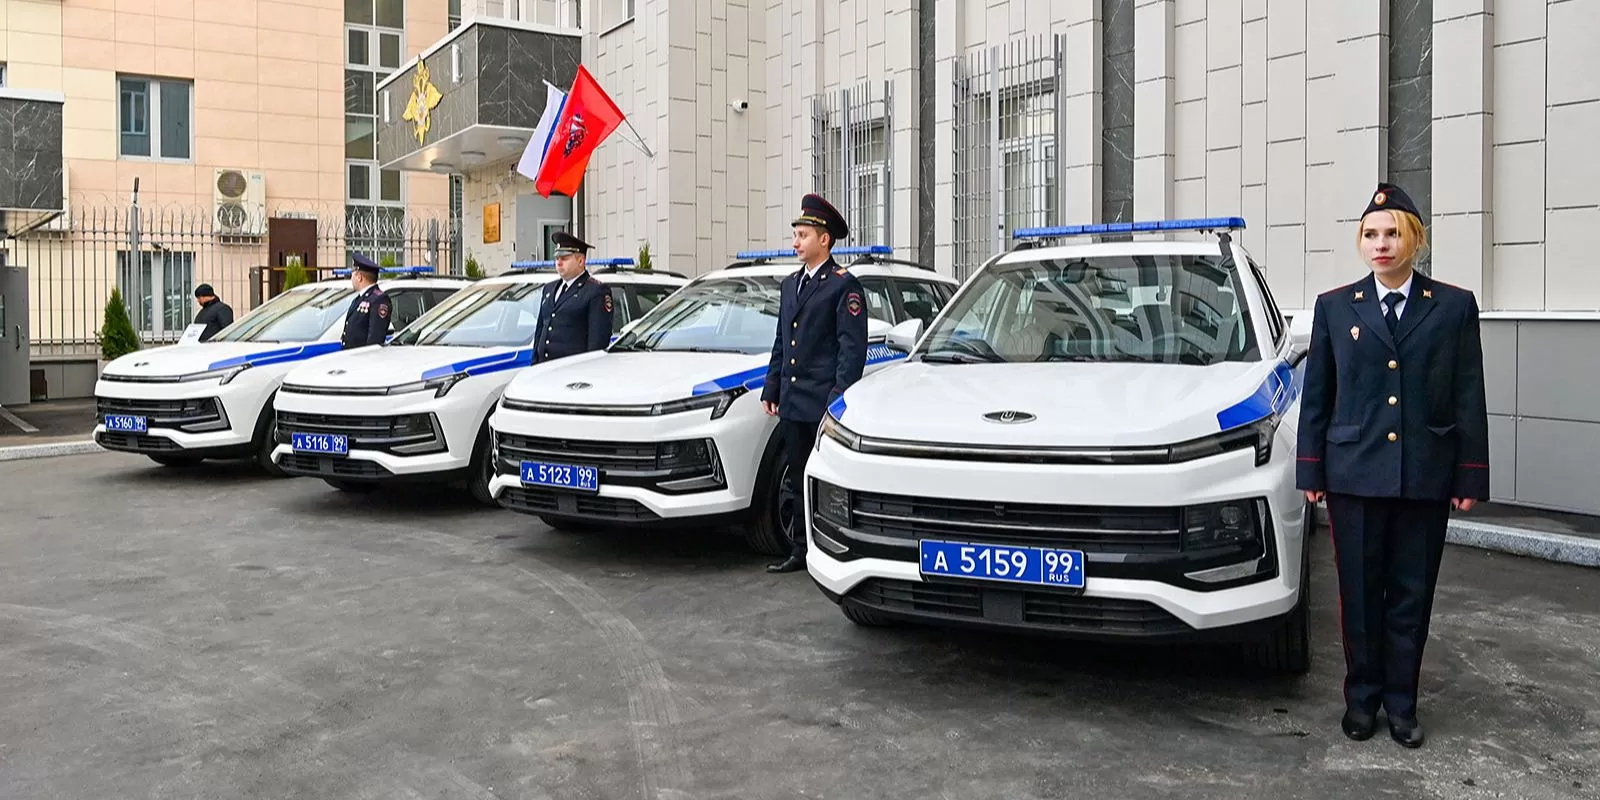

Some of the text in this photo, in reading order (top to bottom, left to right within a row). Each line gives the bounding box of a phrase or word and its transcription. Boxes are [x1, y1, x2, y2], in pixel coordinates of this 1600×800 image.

[115, 417, 133, 429] 5160
[305, 435, 329, 450] 5116
[334, 436, 344, 448] 99
[539, 465, 571, 485] 5123
[578, 468, 593, 482] 99
[960, 546, 1028, 578] 5159
[1045, 551, 1073, 574] 99
[1049, 573, 1070, 583] RUS
